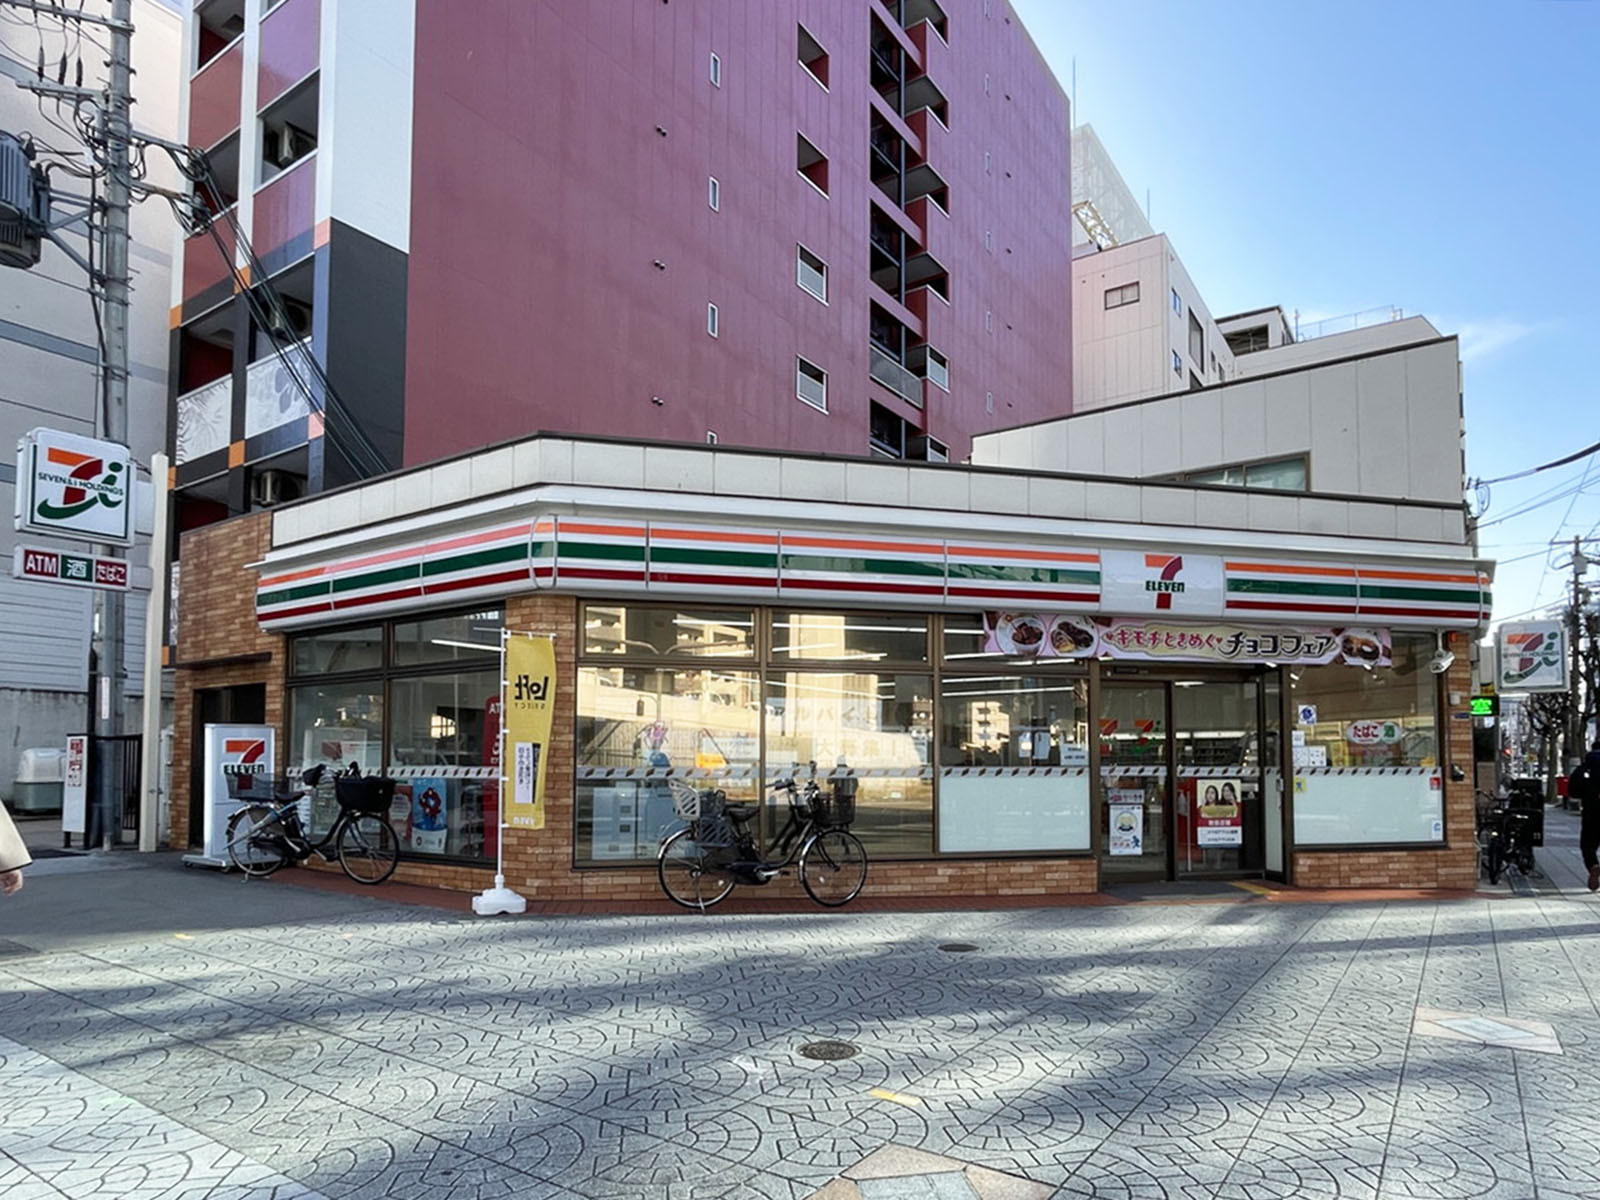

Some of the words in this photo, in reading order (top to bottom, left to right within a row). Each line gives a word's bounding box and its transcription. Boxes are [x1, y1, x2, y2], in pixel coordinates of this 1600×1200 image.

[79, 480, 124, 497] HOLDINGS
[25, 554, 57, 574] ATM
[66, 559, 88, 578] 酒
[96, 563, 126, 583] たばこ
[1218, 631, 1334, 656] チョコフェア
[1352, 724, 1380, 739] たばこ
